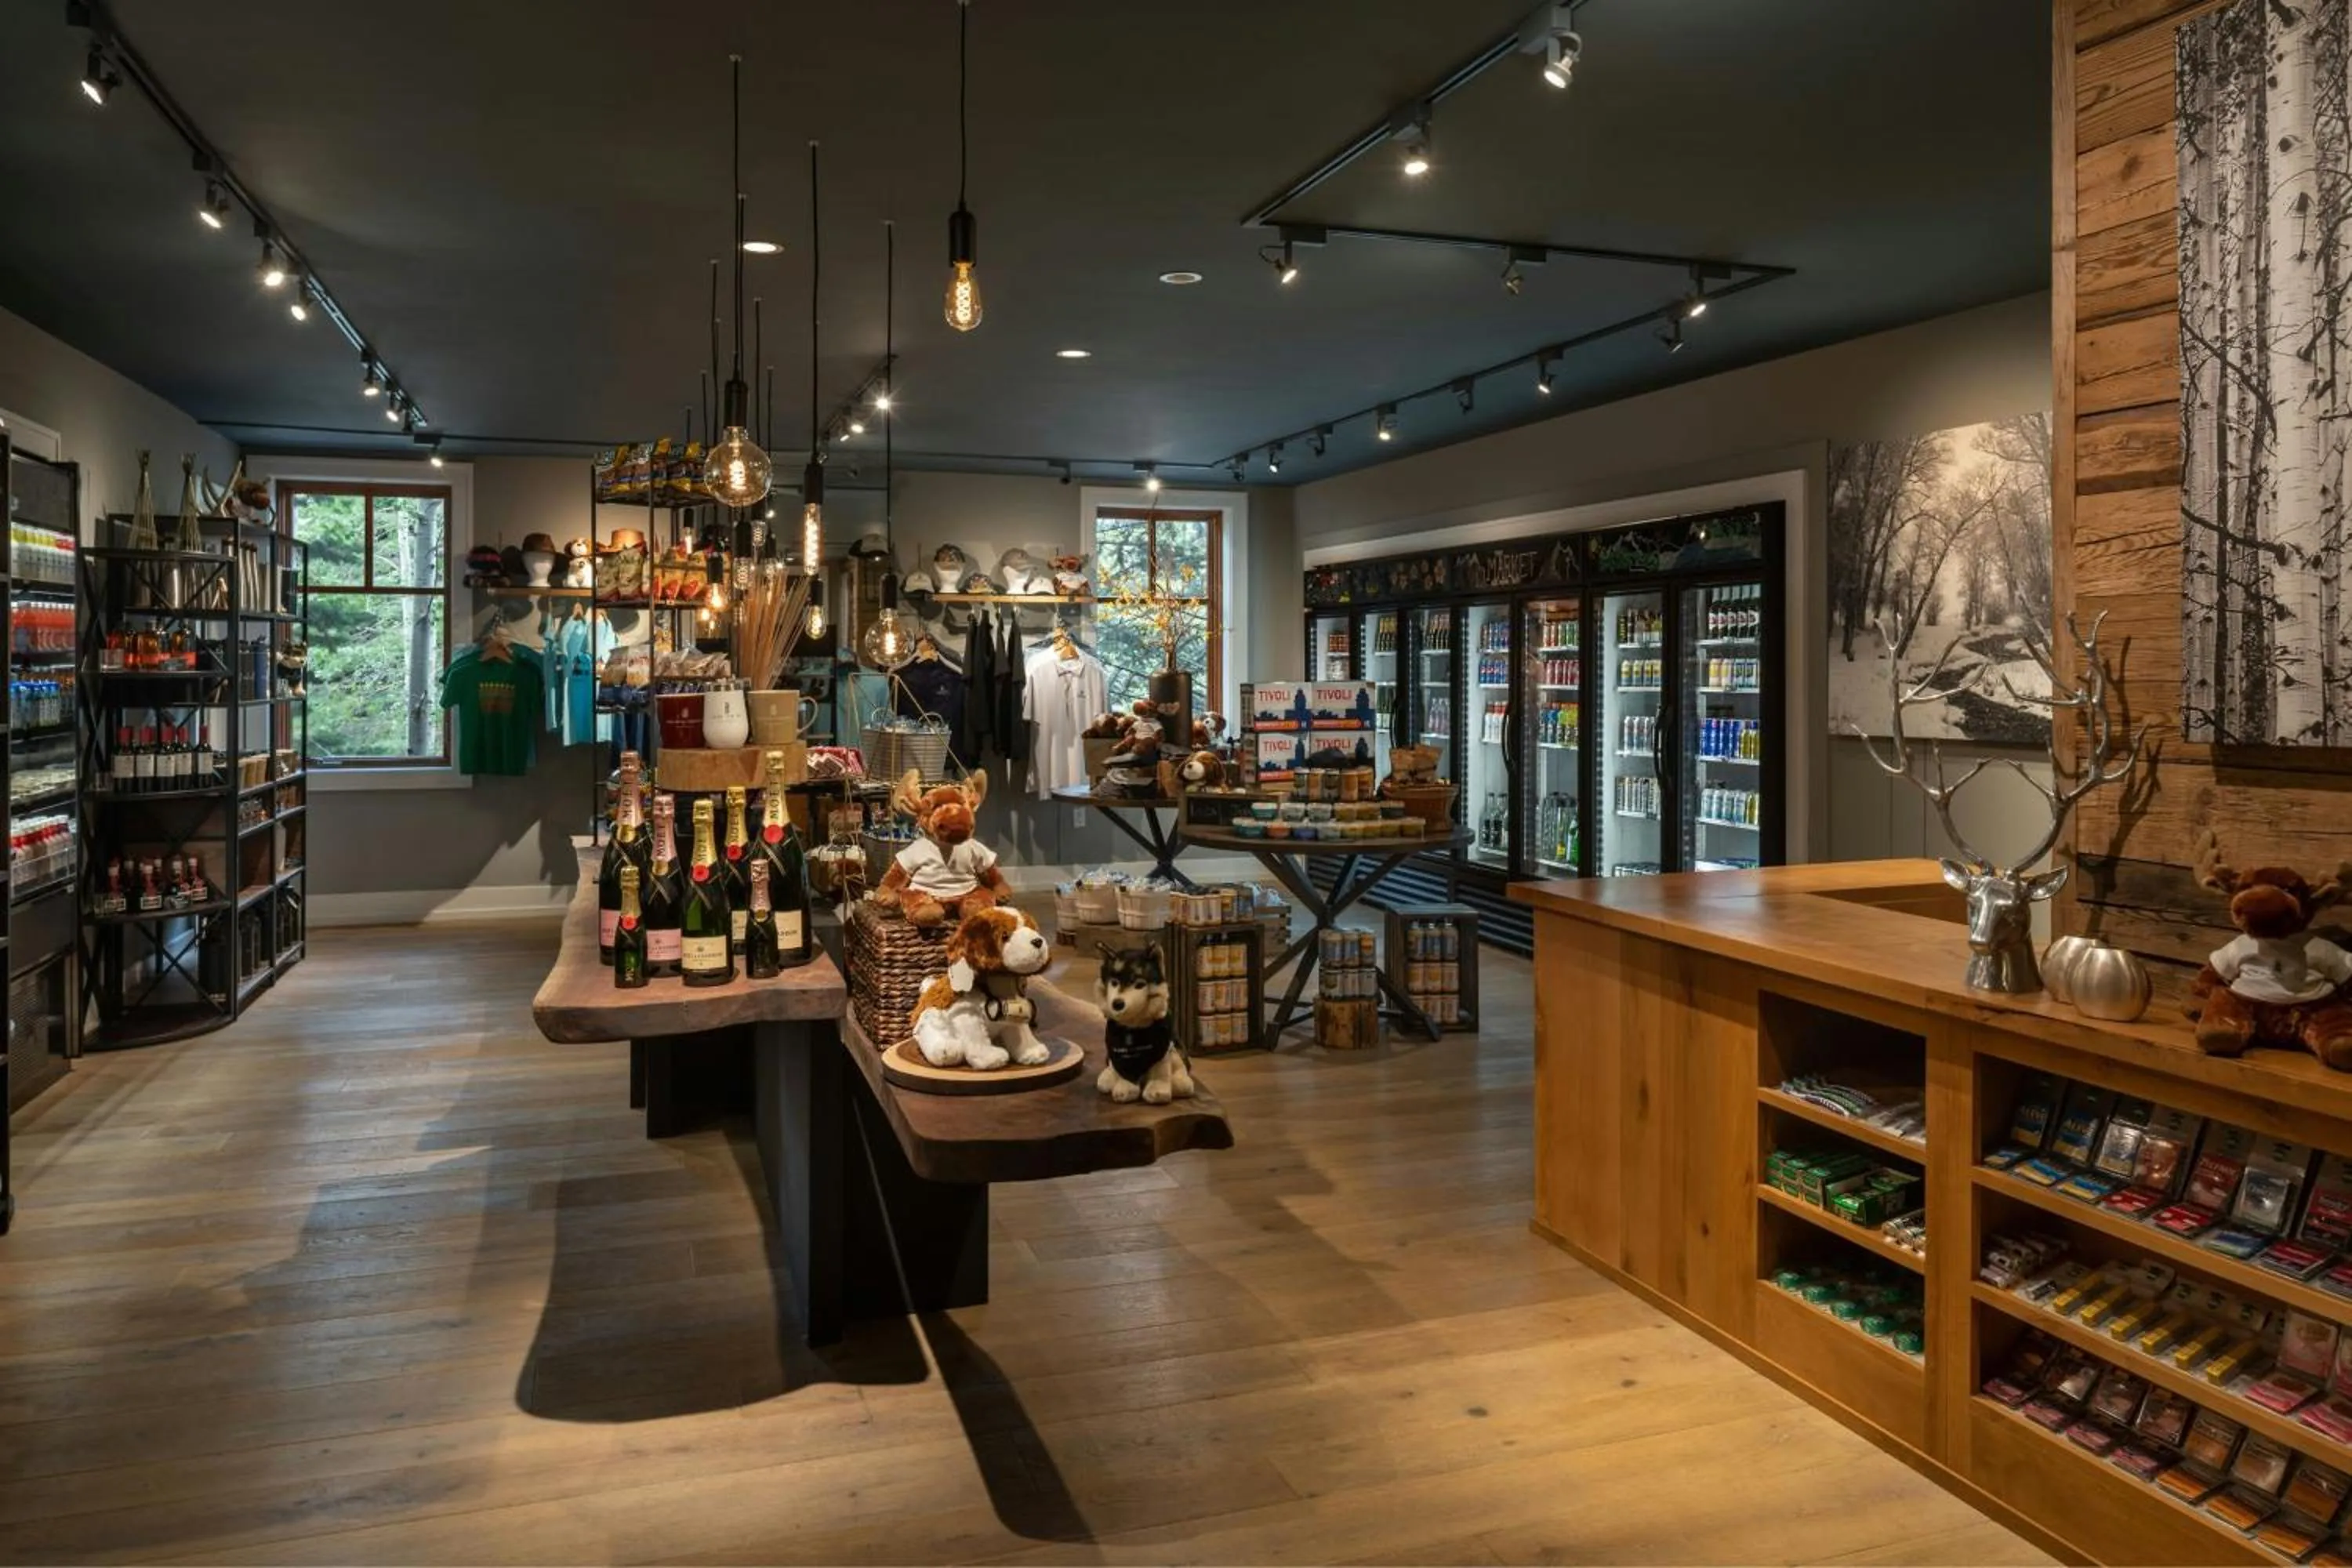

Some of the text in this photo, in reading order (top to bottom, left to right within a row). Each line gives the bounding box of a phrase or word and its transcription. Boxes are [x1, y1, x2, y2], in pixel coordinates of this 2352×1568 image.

[1258, 690, 1290, 702] TIVOLI
[1316, 689, 1352, 700] TIVOLI
[1263, 739, 1292, 752] TIVOLI
[1315, 739, 1351, 750] TIVOLI
